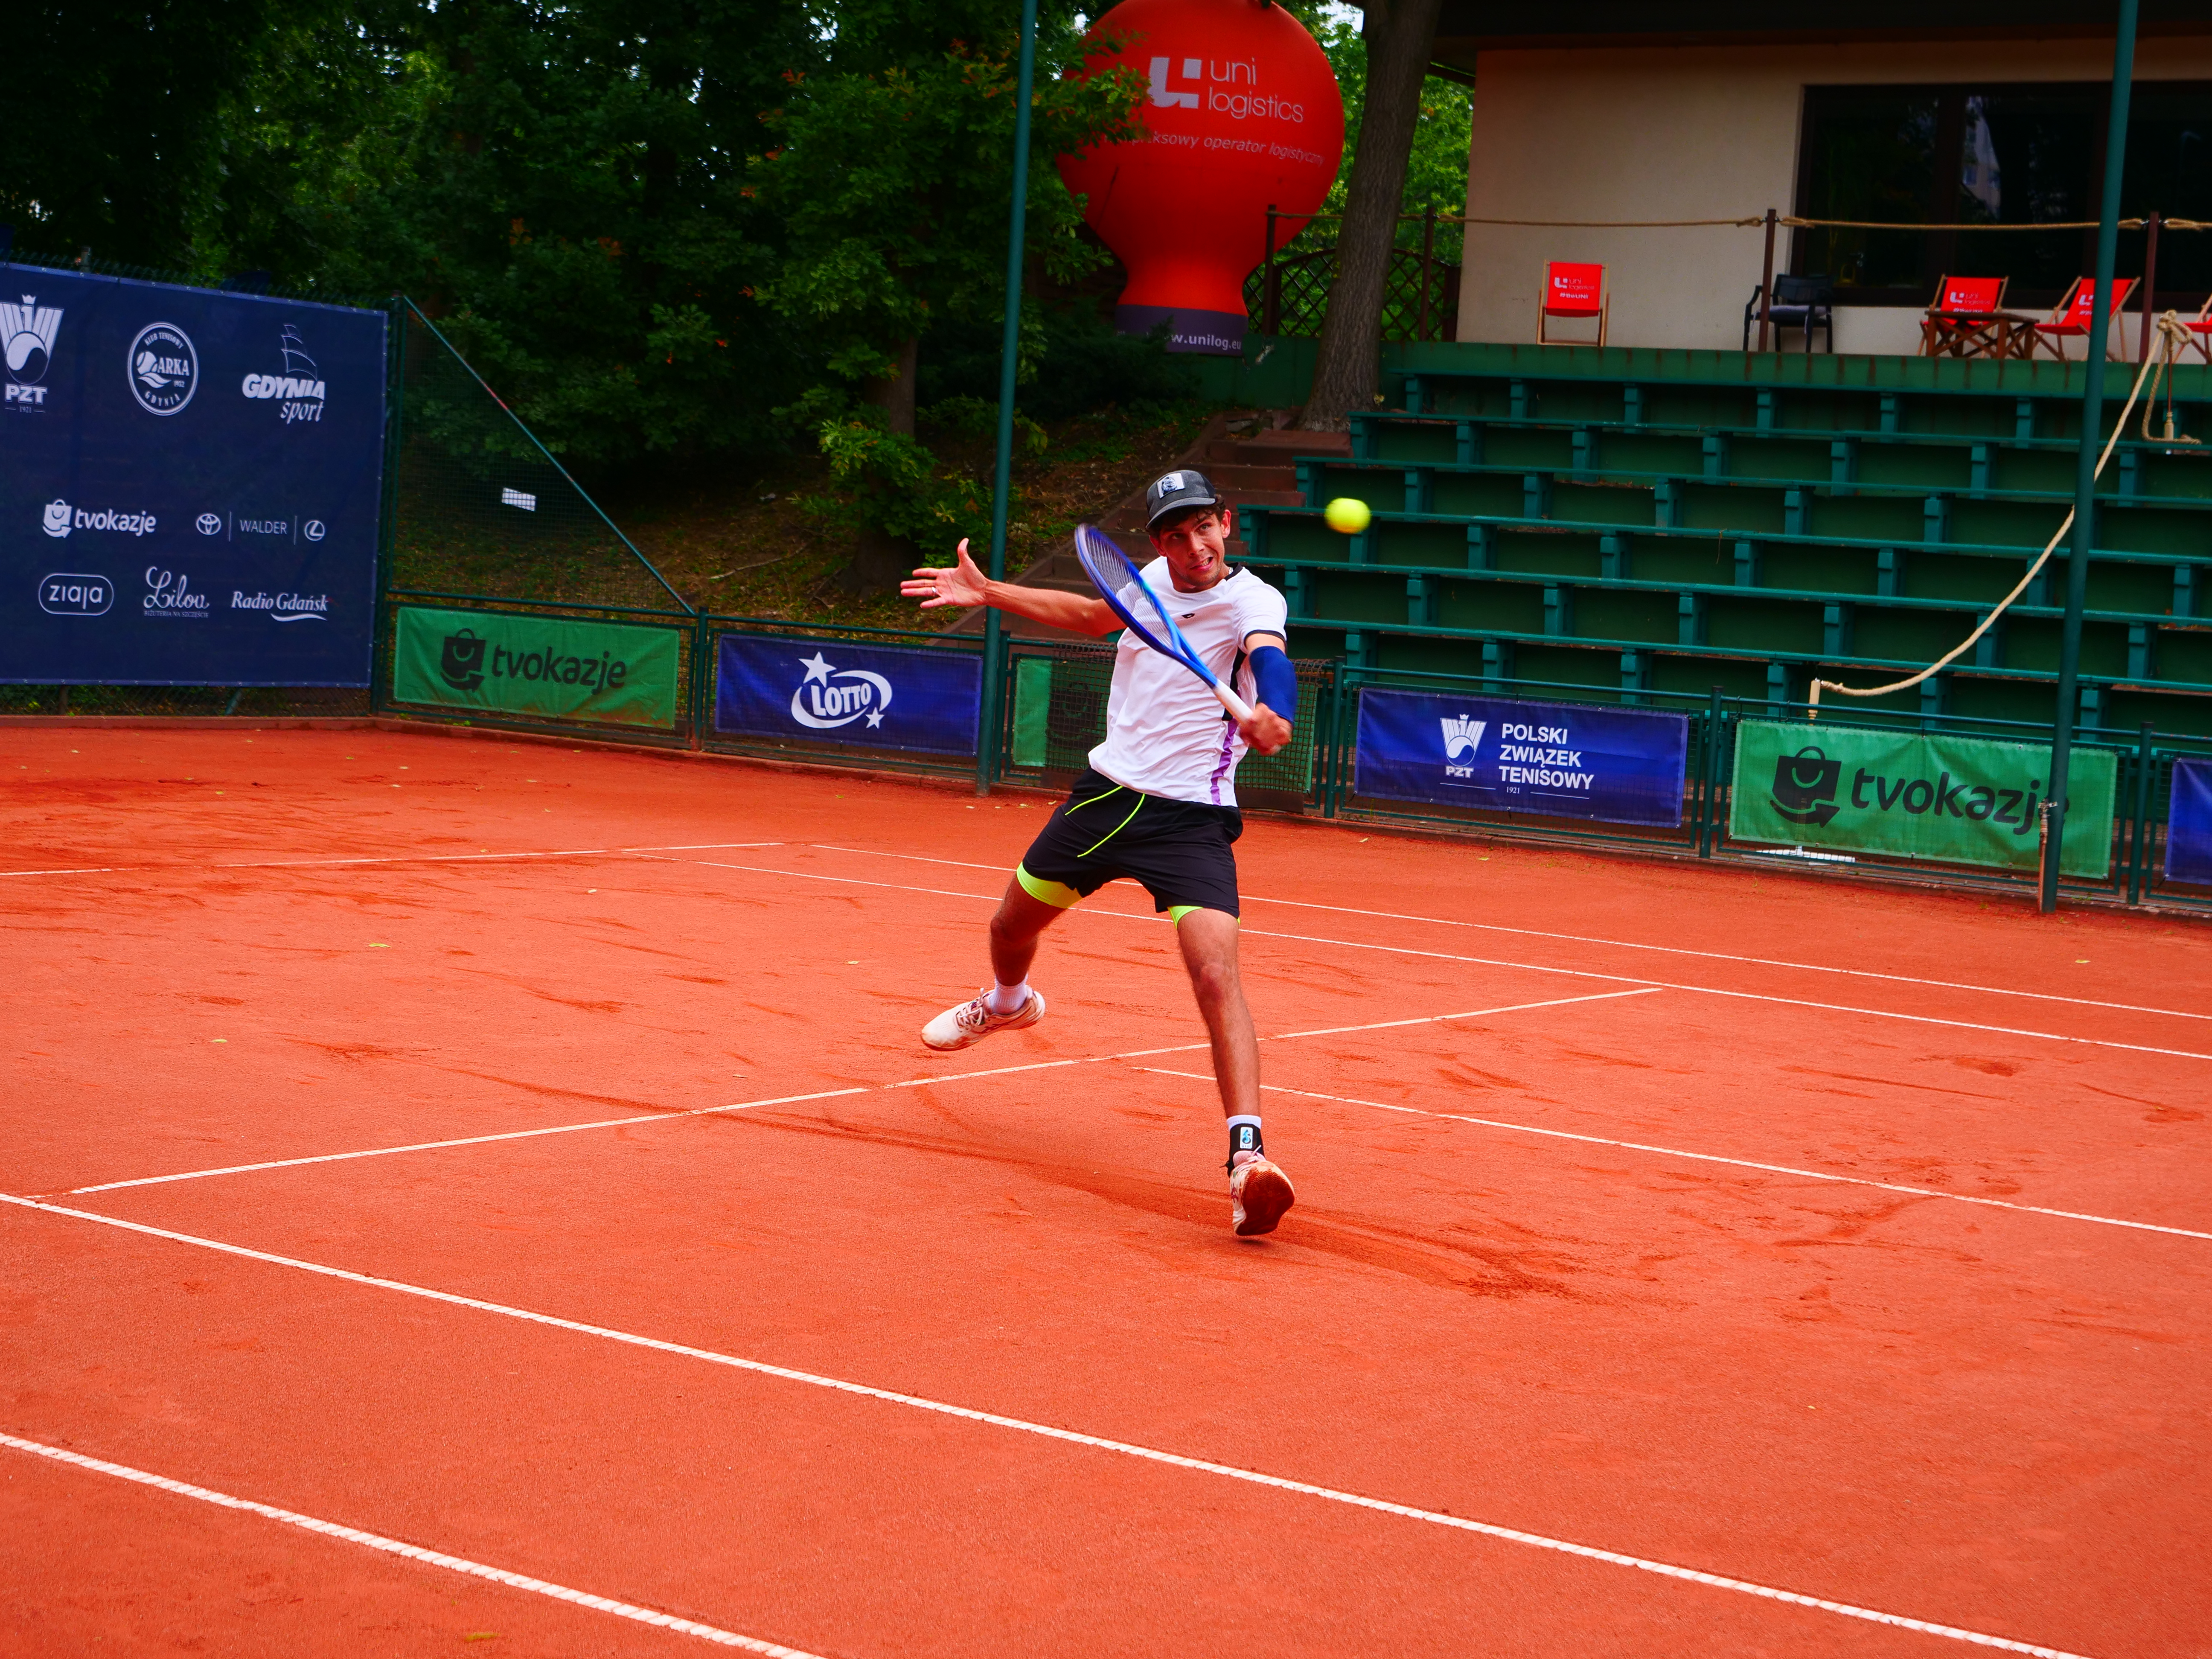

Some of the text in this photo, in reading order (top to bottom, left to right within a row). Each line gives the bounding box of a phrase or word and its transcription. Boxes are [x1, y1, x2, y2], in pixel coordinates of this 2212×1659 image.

[1210, 57, 1256, 85] uni
[1208, 87, 1303, 123] logistics
[1203, 137, 1266, 154] operator
[1269, 142, 1325, 168] logistyczny
[158, 332, 184, 349] TENISOWY
[157, 357, 189, 376] ARKA
[5, 384, 48, 405] PZT
[145, 390, 180, 407] GDYNIA
[242, 373, 325, 401] GDYNIA
[280, 402, 324, 425] sport
[75, 508, 157, 537] tvokazje
[239, 519, 288, 535] WALDER
[49, 585, 103, 609] ziaja
[143, 565, 210, 609] Lilou
[231, 591, 328, 612] Radio Gdańsk
[492, 644, 626, 696] tvokazje
[810, 682, 871, 716] LOTTO
[1502, 723, 1568, 745] POLSKI
[1499, 745, 1581, 768] ZWIĄZEK
[1446, 765, 1474, 779] PZT
[1499, 765, 1595, 790] TENISOWY
[1506, 786, 1520, 794] 1921
